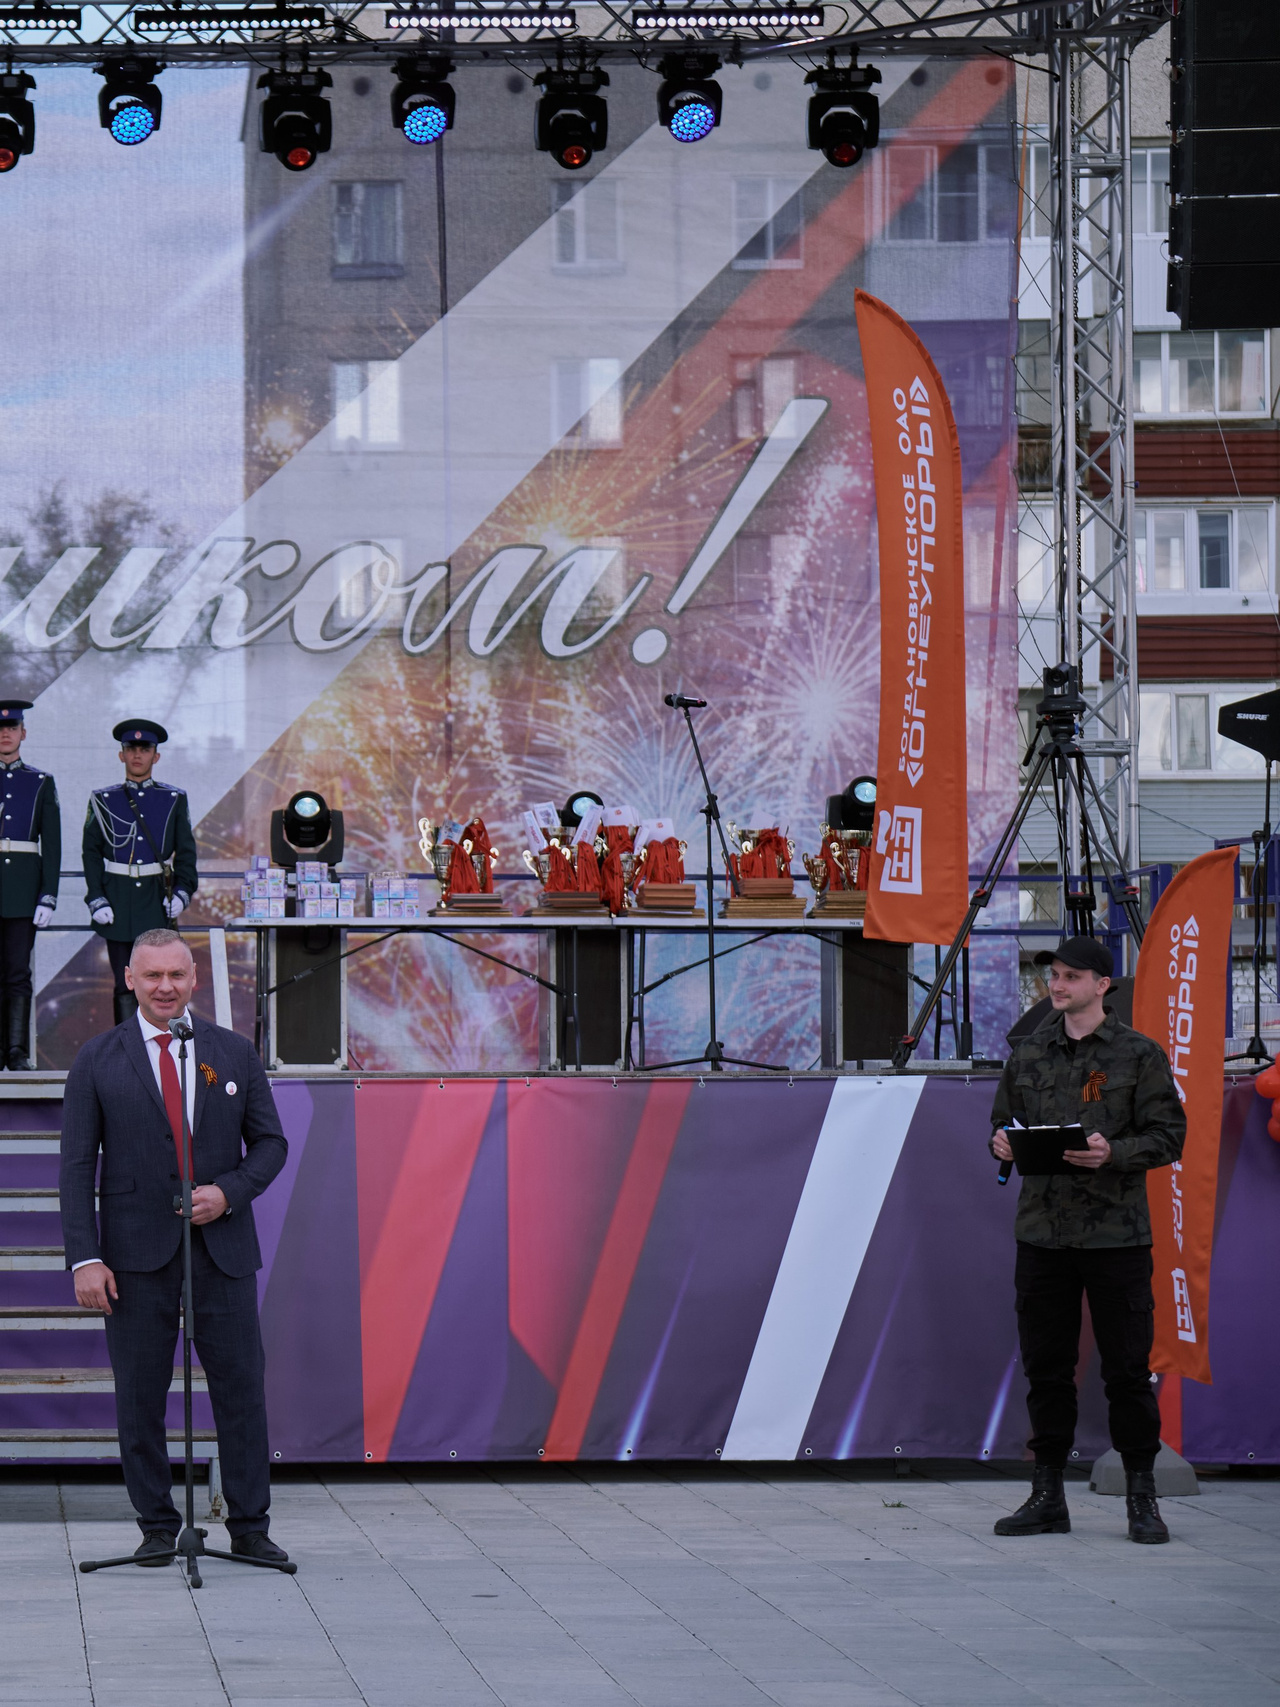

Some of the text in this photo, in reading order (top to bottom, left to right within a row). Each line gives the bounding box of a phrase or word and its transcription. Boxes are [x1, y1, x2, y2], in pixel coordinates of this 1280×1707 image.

[892, 387, 919, 772] БОГДАНОВИЧСКОЕ ОАО
[1168, 924, 1181, 980] ОАО
